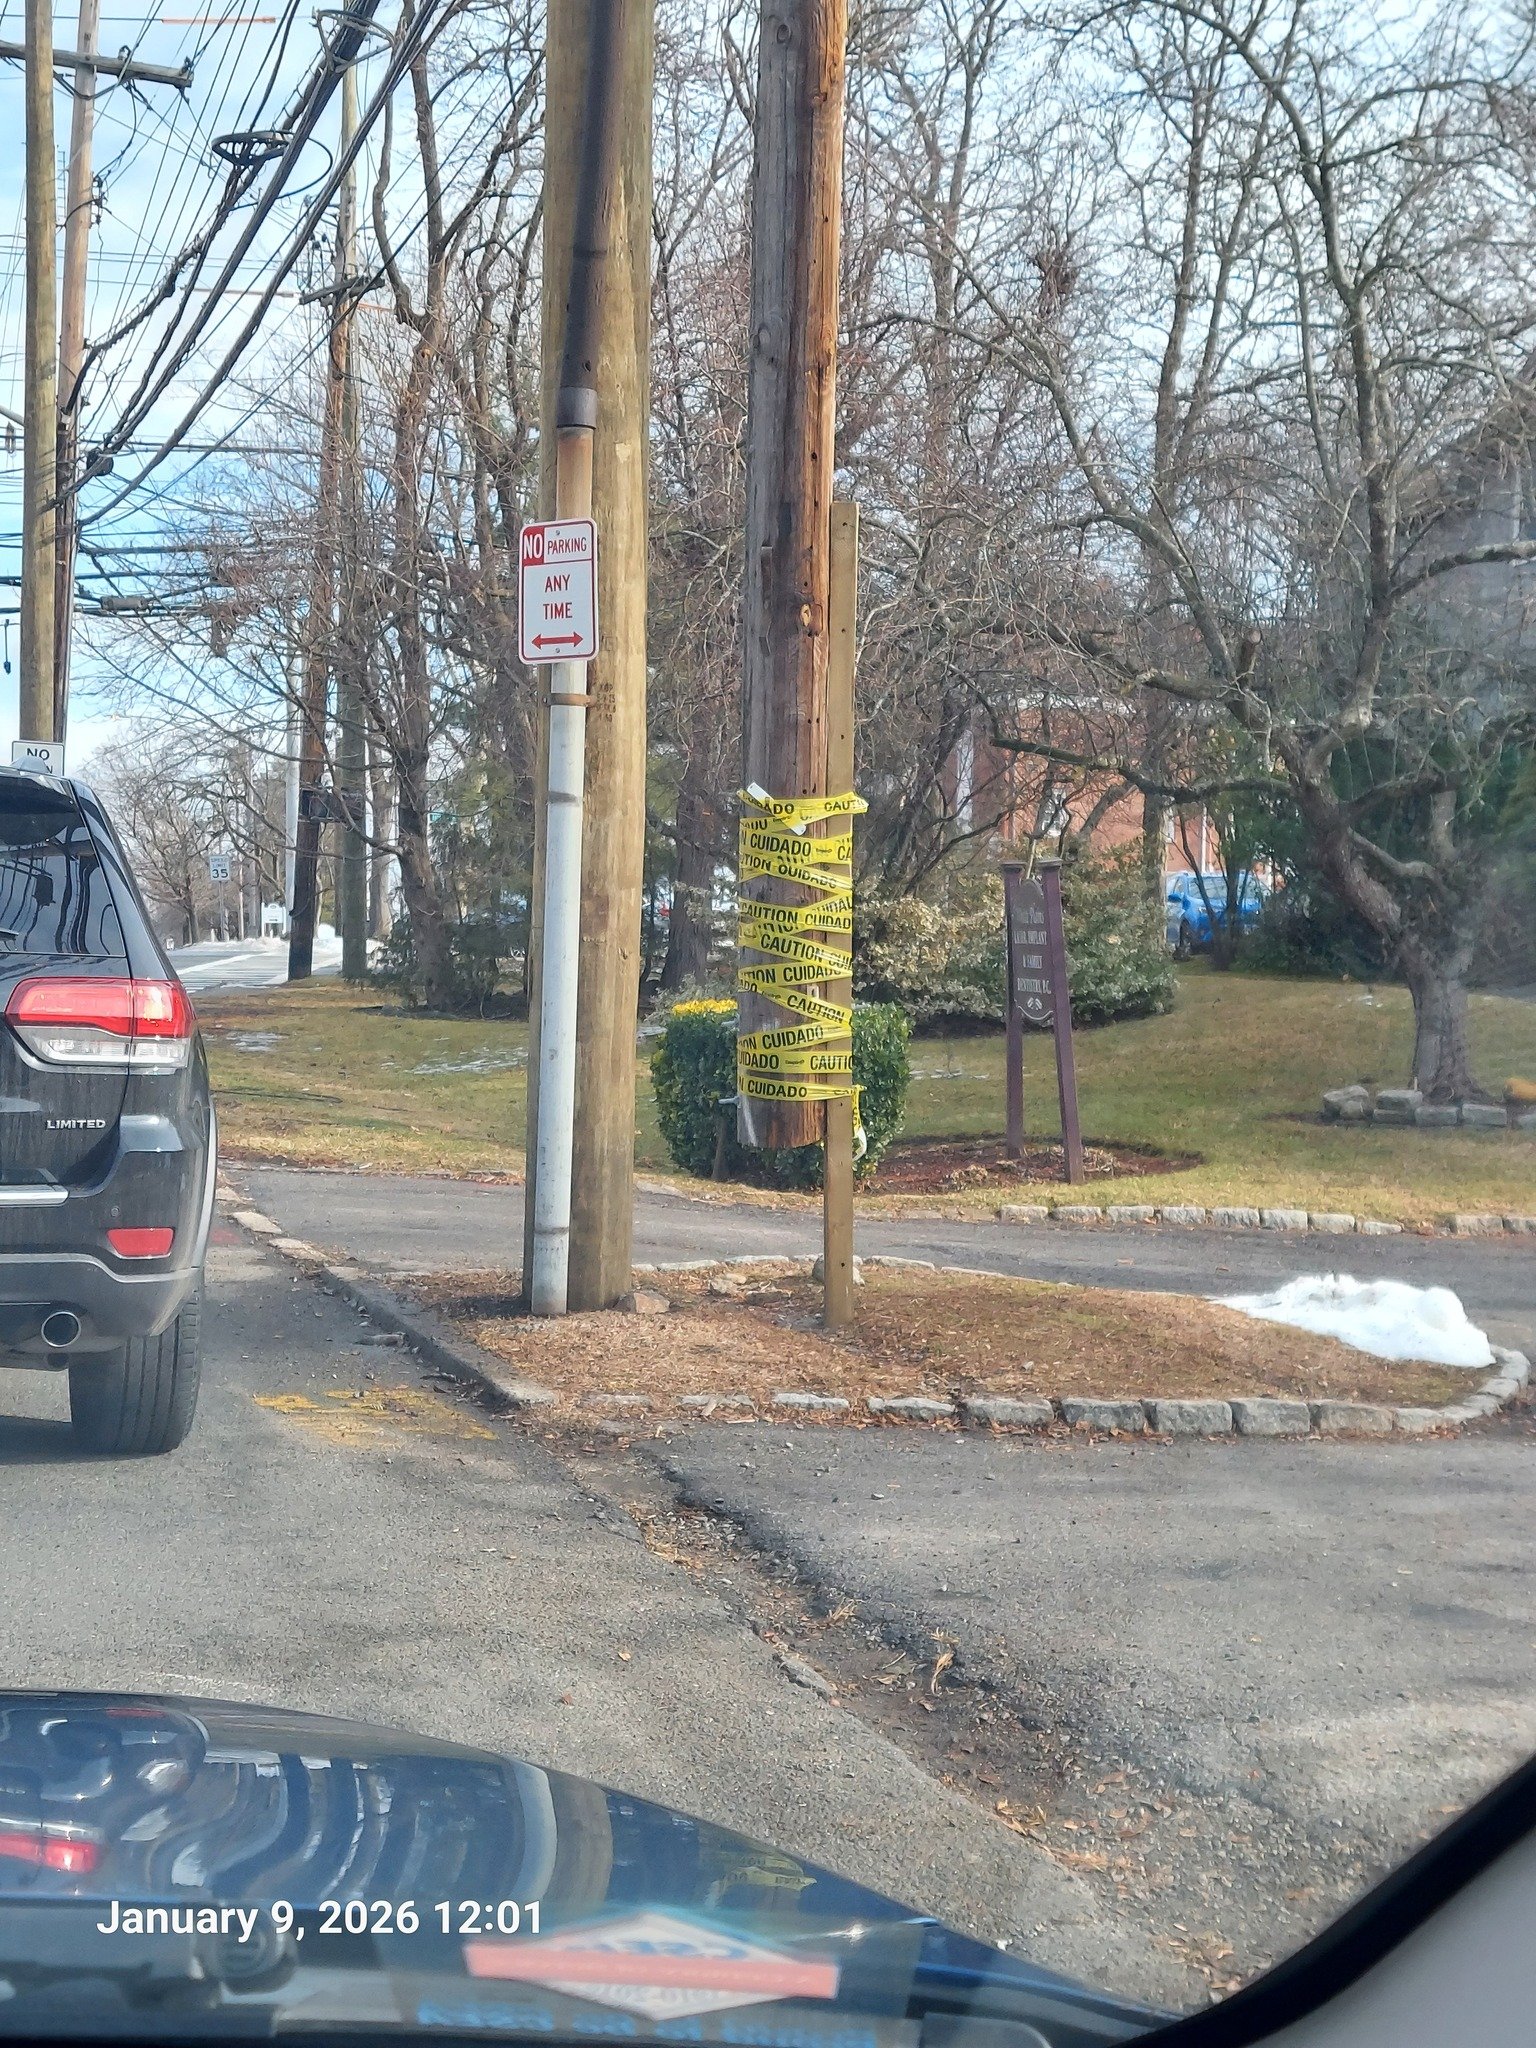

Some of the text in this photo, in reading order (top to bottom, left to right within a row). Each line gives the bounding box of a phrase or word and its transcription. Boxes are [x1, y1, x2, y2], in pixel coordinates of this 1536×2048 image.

[523, 533, 587, 560] NO PARKING
[545, 574, 571, 593] ANY
[543, 602, 573, 620] TIME
[27, 747, 50, 761] NO
[751, 832, 811, 858] CUIDADO
[212, 868, 228, 878] 35
[761, 933, 824, 963] CAUTION
[787, 994, 845, 1024] CAUTION
[762, 1025, 824, 1050] CUIDADO
[748, 1079, 807, 1098] CUIDADO
[46, 1119, 106, 1129] LIMITED
